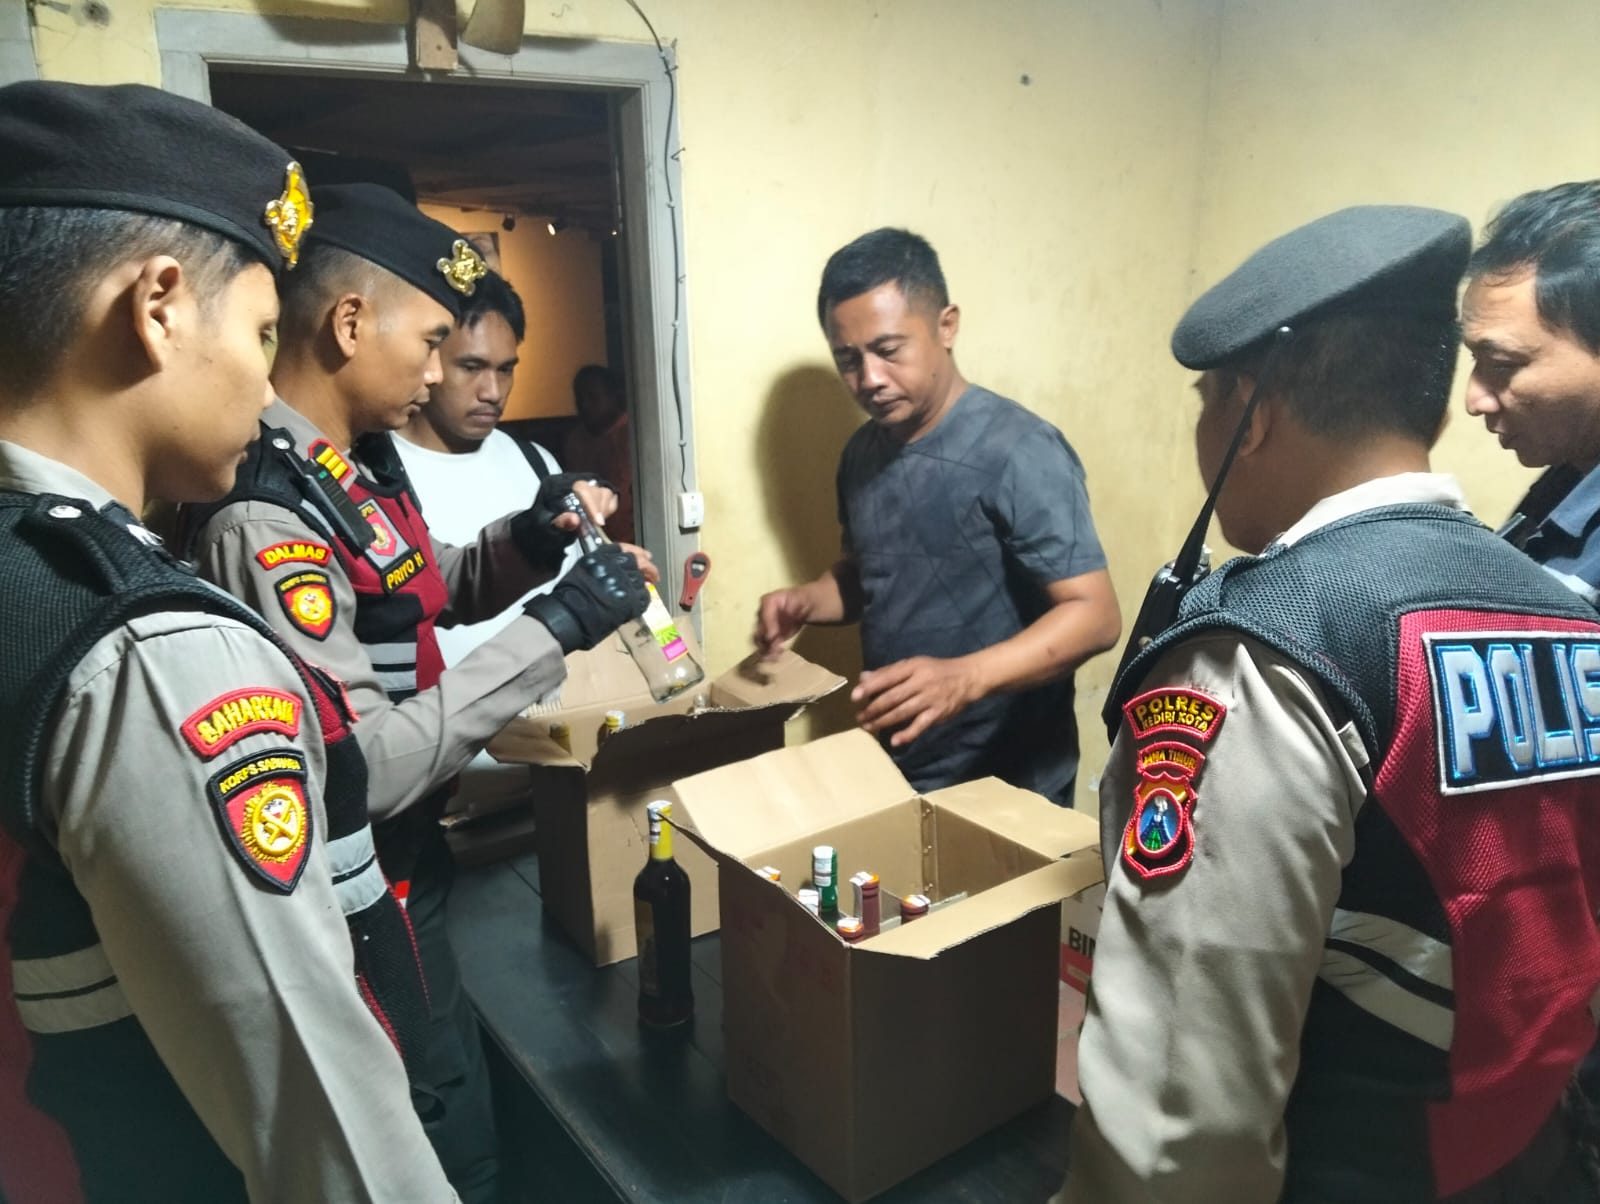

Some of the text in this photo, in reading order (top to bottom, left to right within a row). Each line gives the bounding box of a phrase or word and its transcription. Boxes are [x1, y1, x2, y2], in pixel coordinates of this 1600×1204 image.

[264, 544, 326, 564] DALMAS
[386, 552, 424, 589] PRIYO H
[1135, 695, 1216, 721] POLRES
[1142, 711, 1208, 732] KEDIRI KOTA
